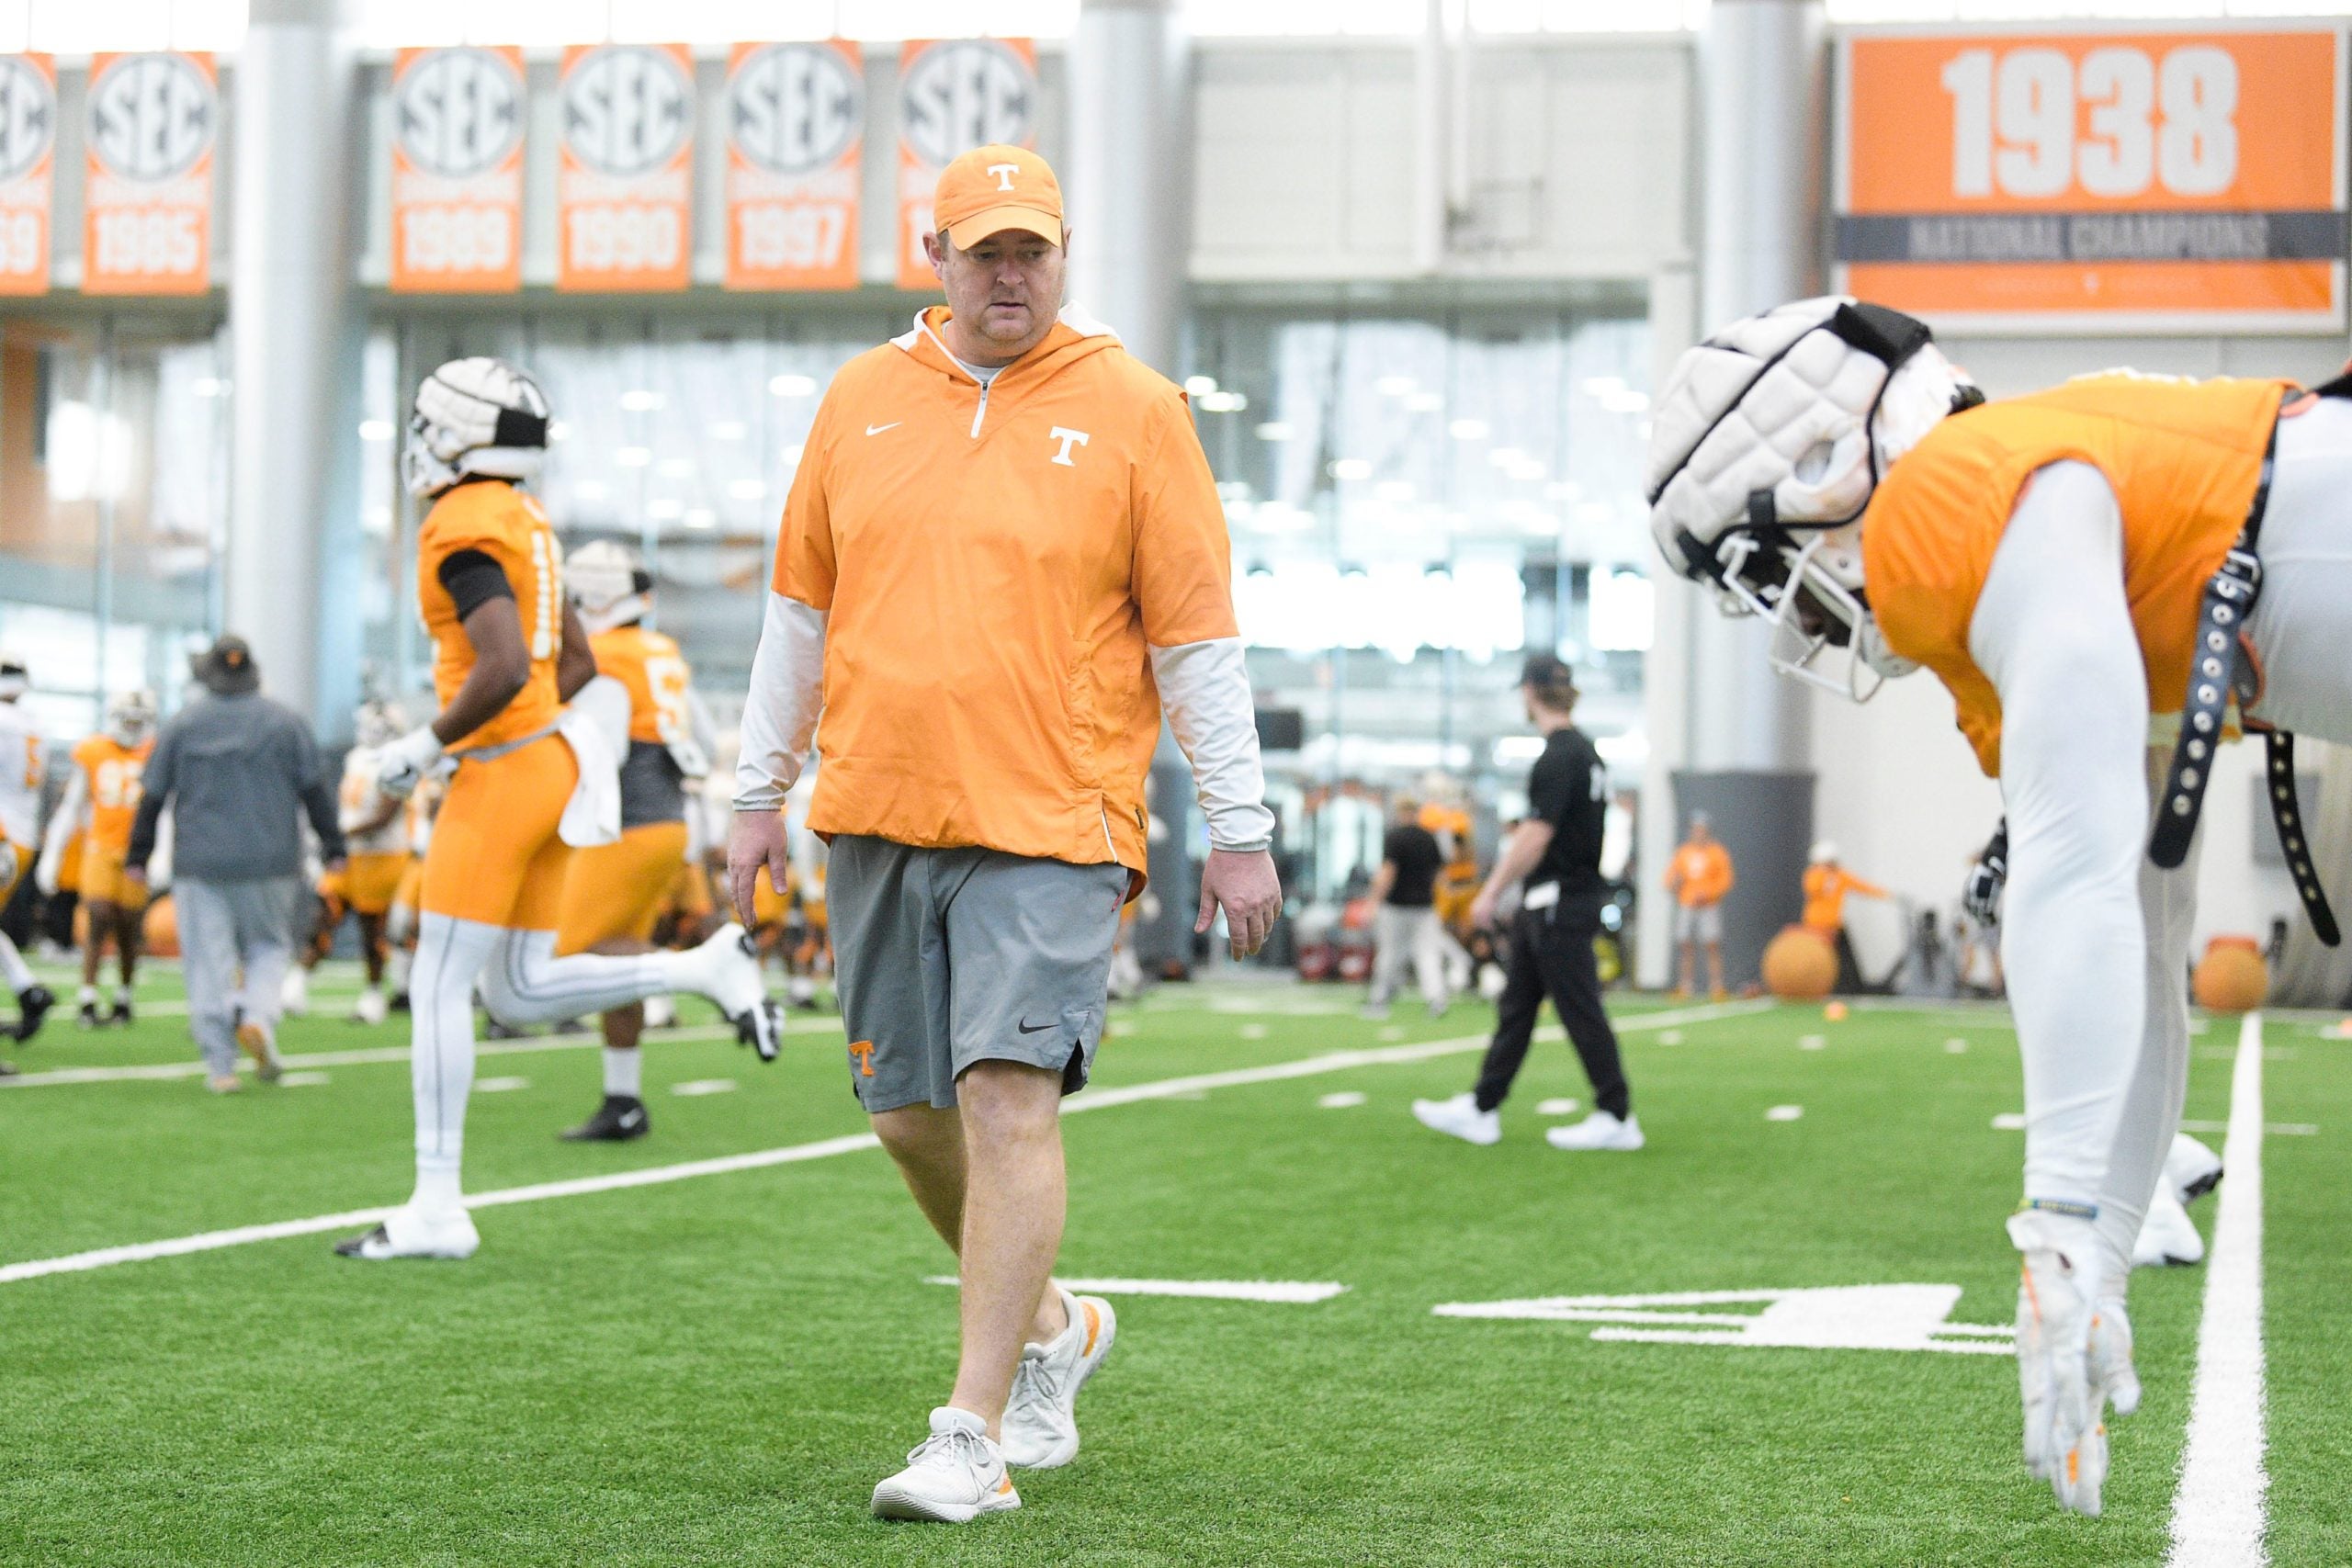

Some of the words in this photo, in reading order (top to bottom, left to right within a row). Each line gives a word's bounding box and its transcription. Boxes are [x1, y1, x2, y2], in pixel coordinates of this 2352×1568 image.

[97, 57, 206, 174] SEC
[401, 52, 513, 172] SEC
[569, 51, 682, 169] SEC
[736, 48, 851, 165] SEC
[1941, 44, 2239, 198] 1938
[987, 164, 1019, 191] T
[96, 212, 198, 274] 1985
[570, 209, 679, 270] 1990
[741, 207, 844, 269] 1997
[1908, 215, 2061, 259] NATIONAL
[2070, 213, 2269, 259] CHAMPIONS
[1049, 426, 1089, 466] T
[849, 1040, 875, 1077] T
